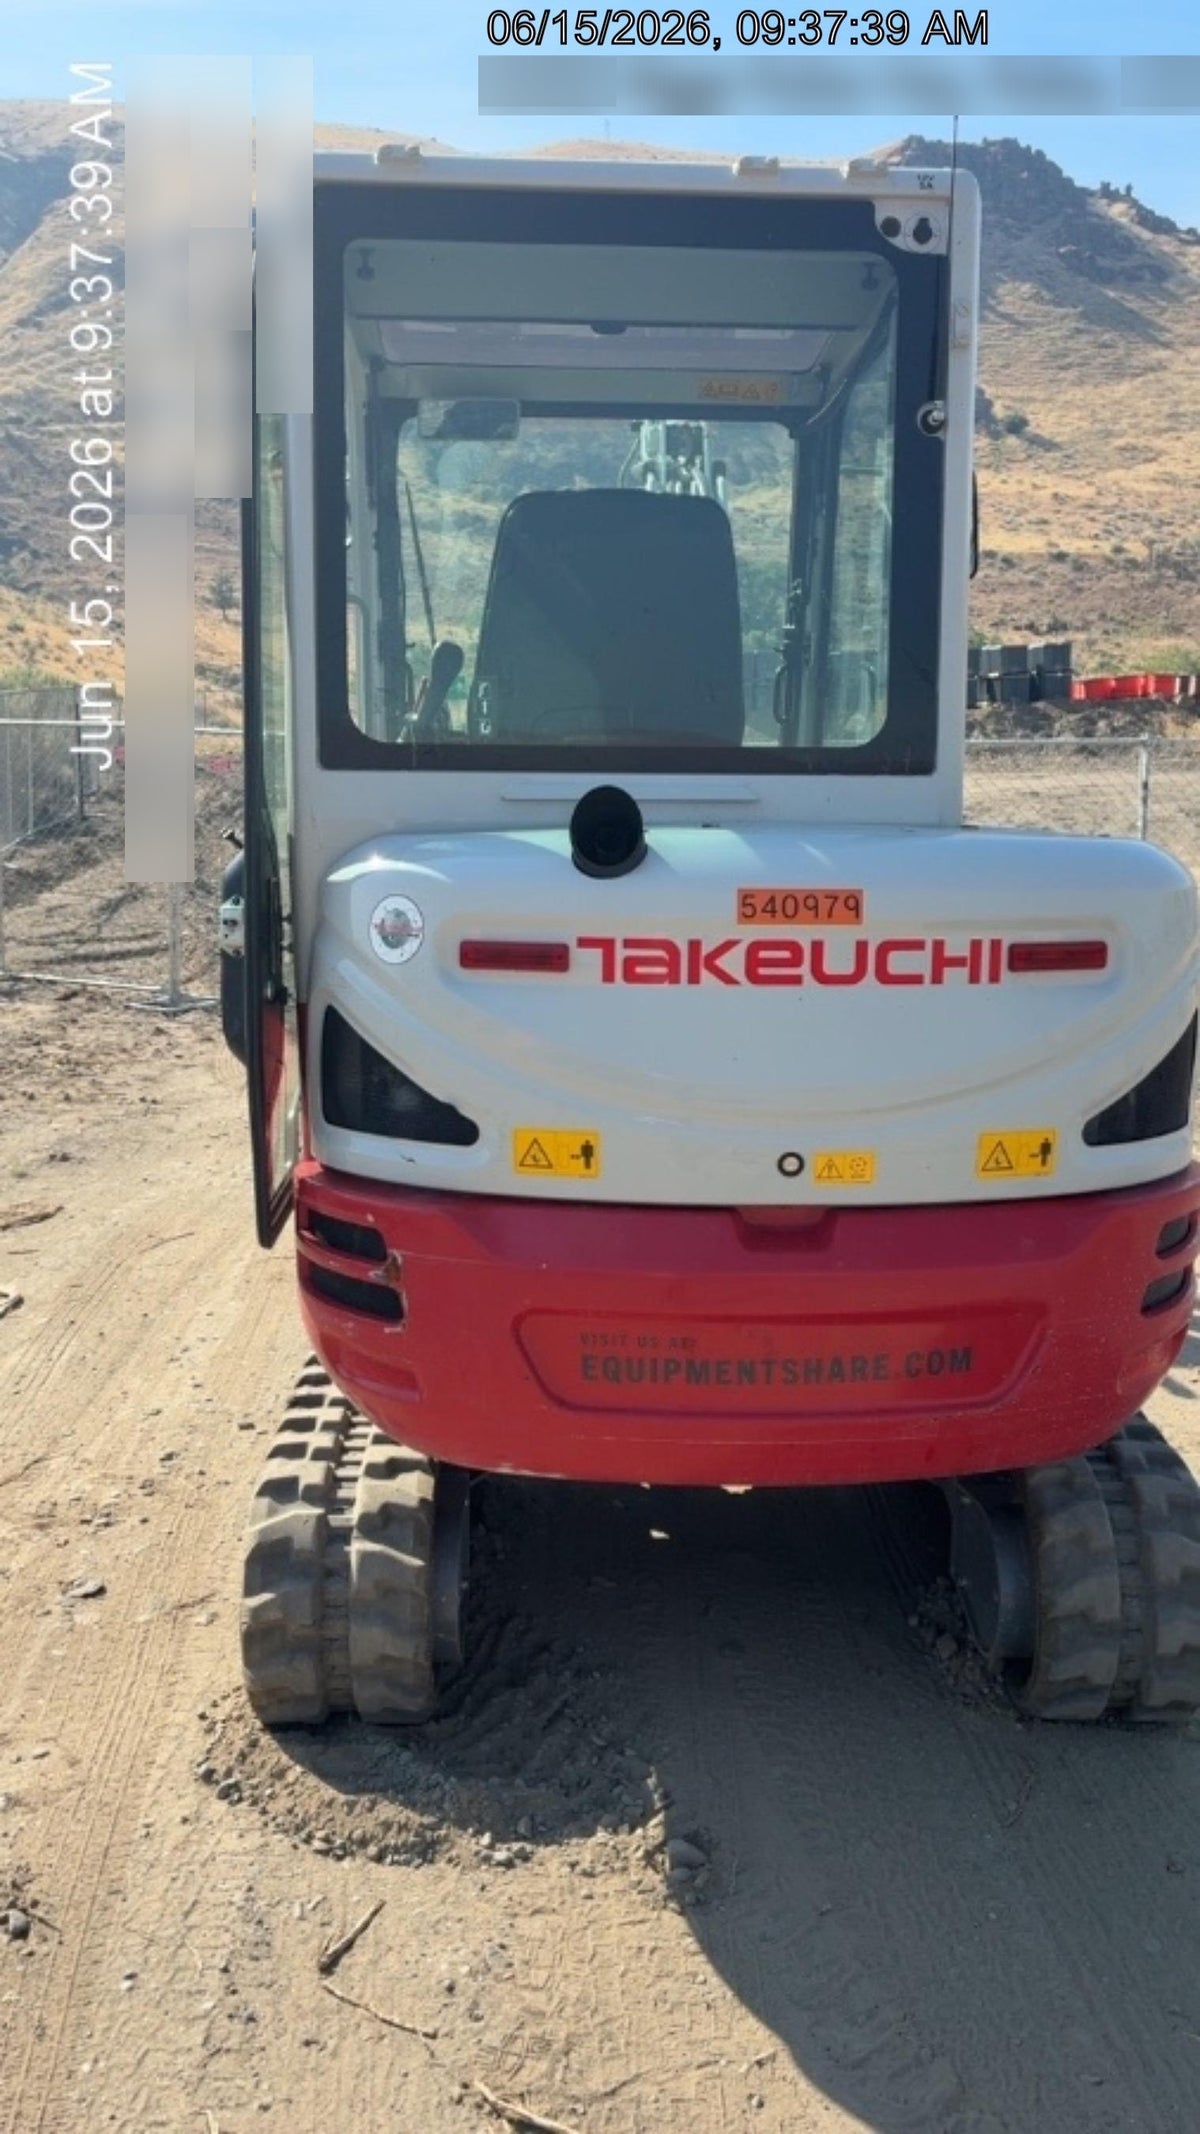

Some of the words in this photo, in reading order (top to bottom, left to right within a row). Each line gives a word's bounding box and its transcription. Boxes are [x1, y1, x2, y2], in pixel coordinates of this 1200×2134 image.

[740, 894, 861, 920] 540979
[576, 935, 1003, 986] TAKEUCHI
[580, 1332, 628, 1348] VISIT
